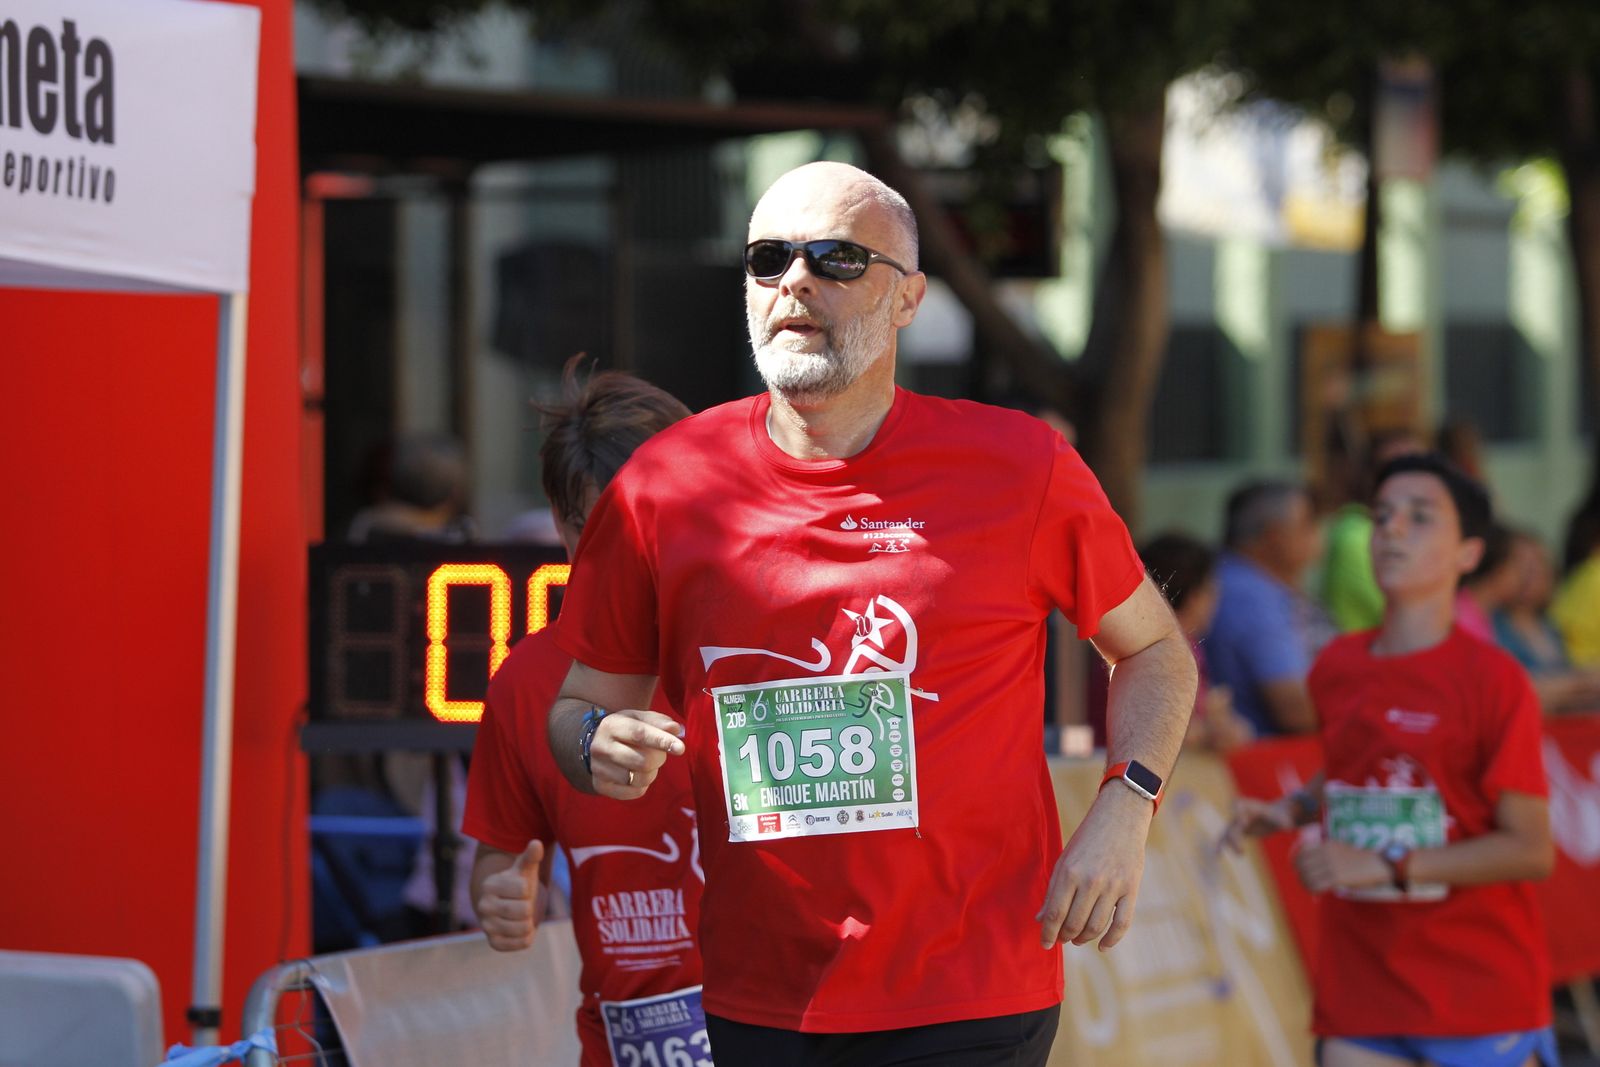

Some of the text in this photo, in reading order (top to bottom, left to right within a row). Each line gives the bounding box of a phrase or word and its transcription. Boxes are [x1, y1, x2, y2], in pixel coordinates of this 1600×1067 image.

[3, 151, 116, 204] eportivo
[860, 517, 925, 530] Santander
[775, 685, 845, 703] CARRERA
[775, 699, 846, 715] SOLIDARIA
[725, 711, 747, 729] 2019
[739, 725, 877, 784] 1058
[760, 776, 876, 808] ENRIQUE MARTÍN
[592, 888, 686, 920] CARRERA
[597, 915, 692, 944] SOLIDARIA
[619, 1027, 714, 1067] 2163
